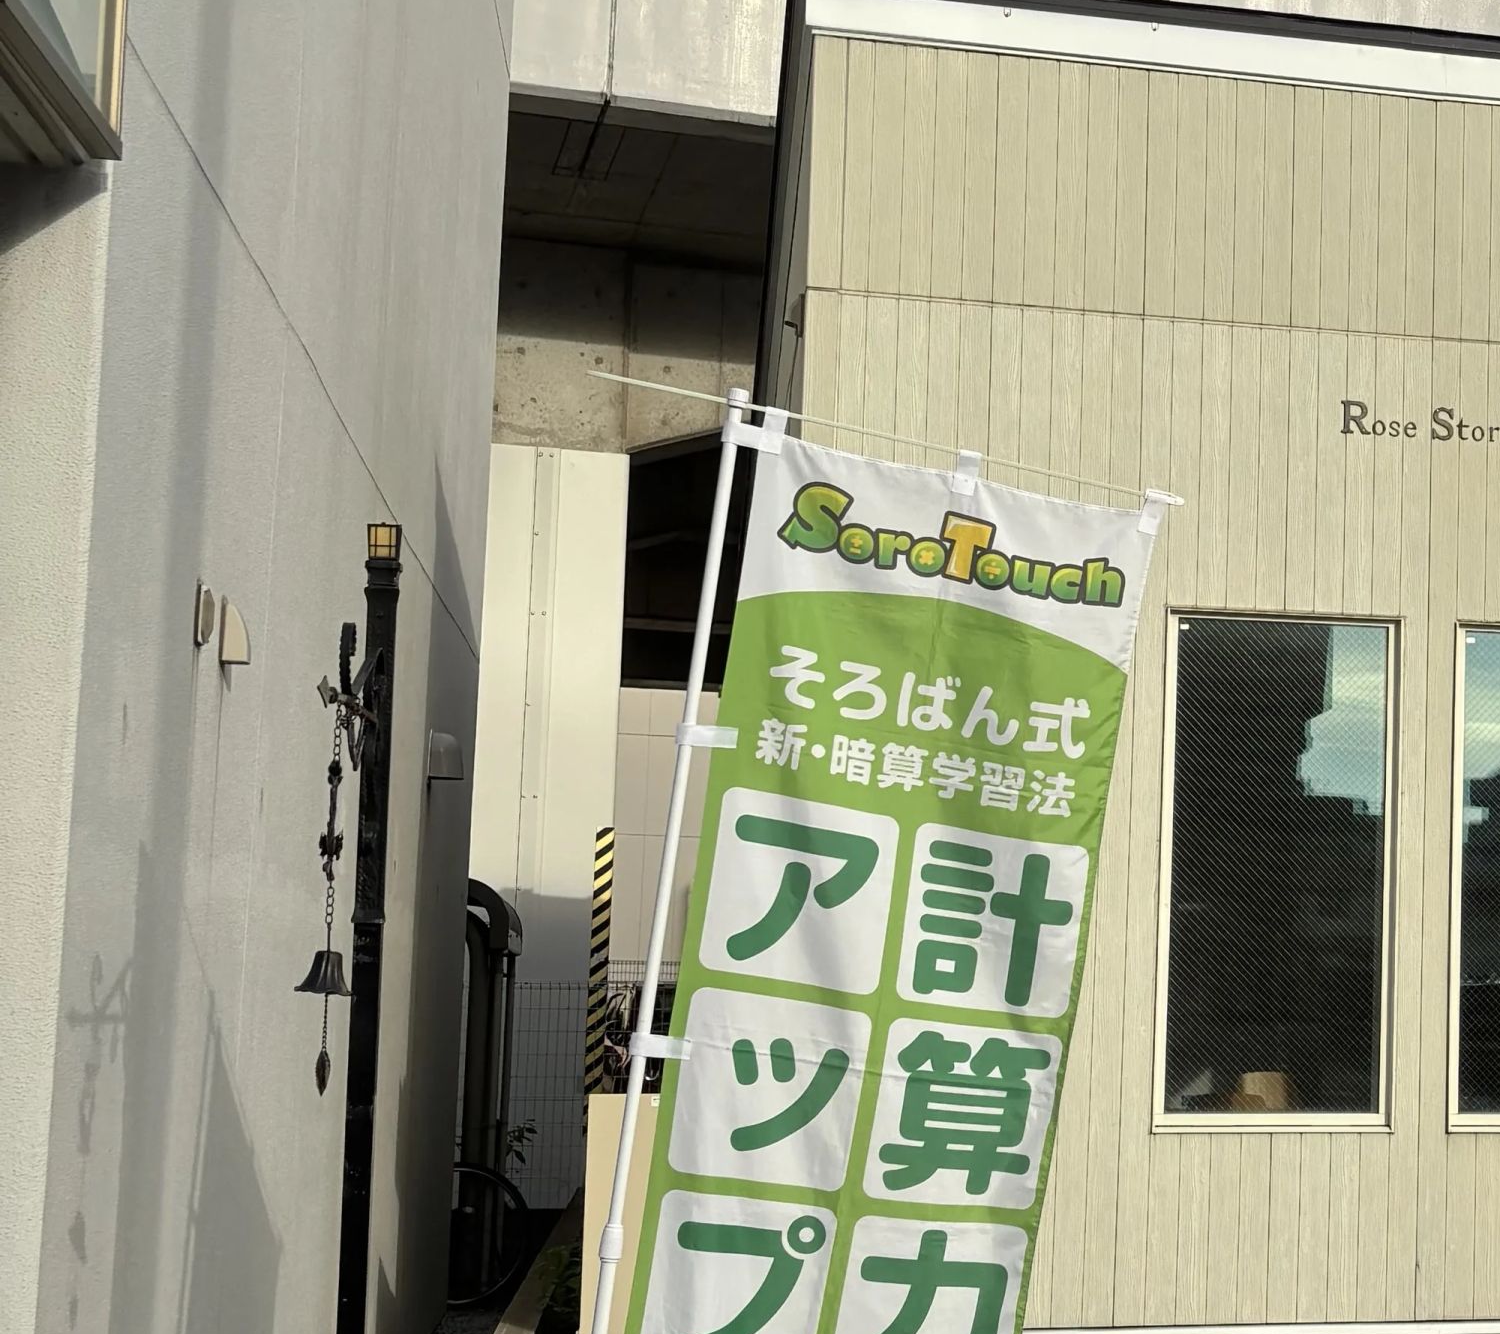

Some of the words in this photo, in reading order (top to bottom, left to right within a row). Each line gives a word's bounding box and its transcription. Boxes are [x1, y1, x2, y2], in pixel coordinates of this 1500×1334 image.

[1340, 399, 1418, 438] Rose
[777, 481, 1126, 608] SoroTouch
[769, 645, 1091, 759] そろばん式
[754, 717, 1076, 818] 新・暗算学習法
